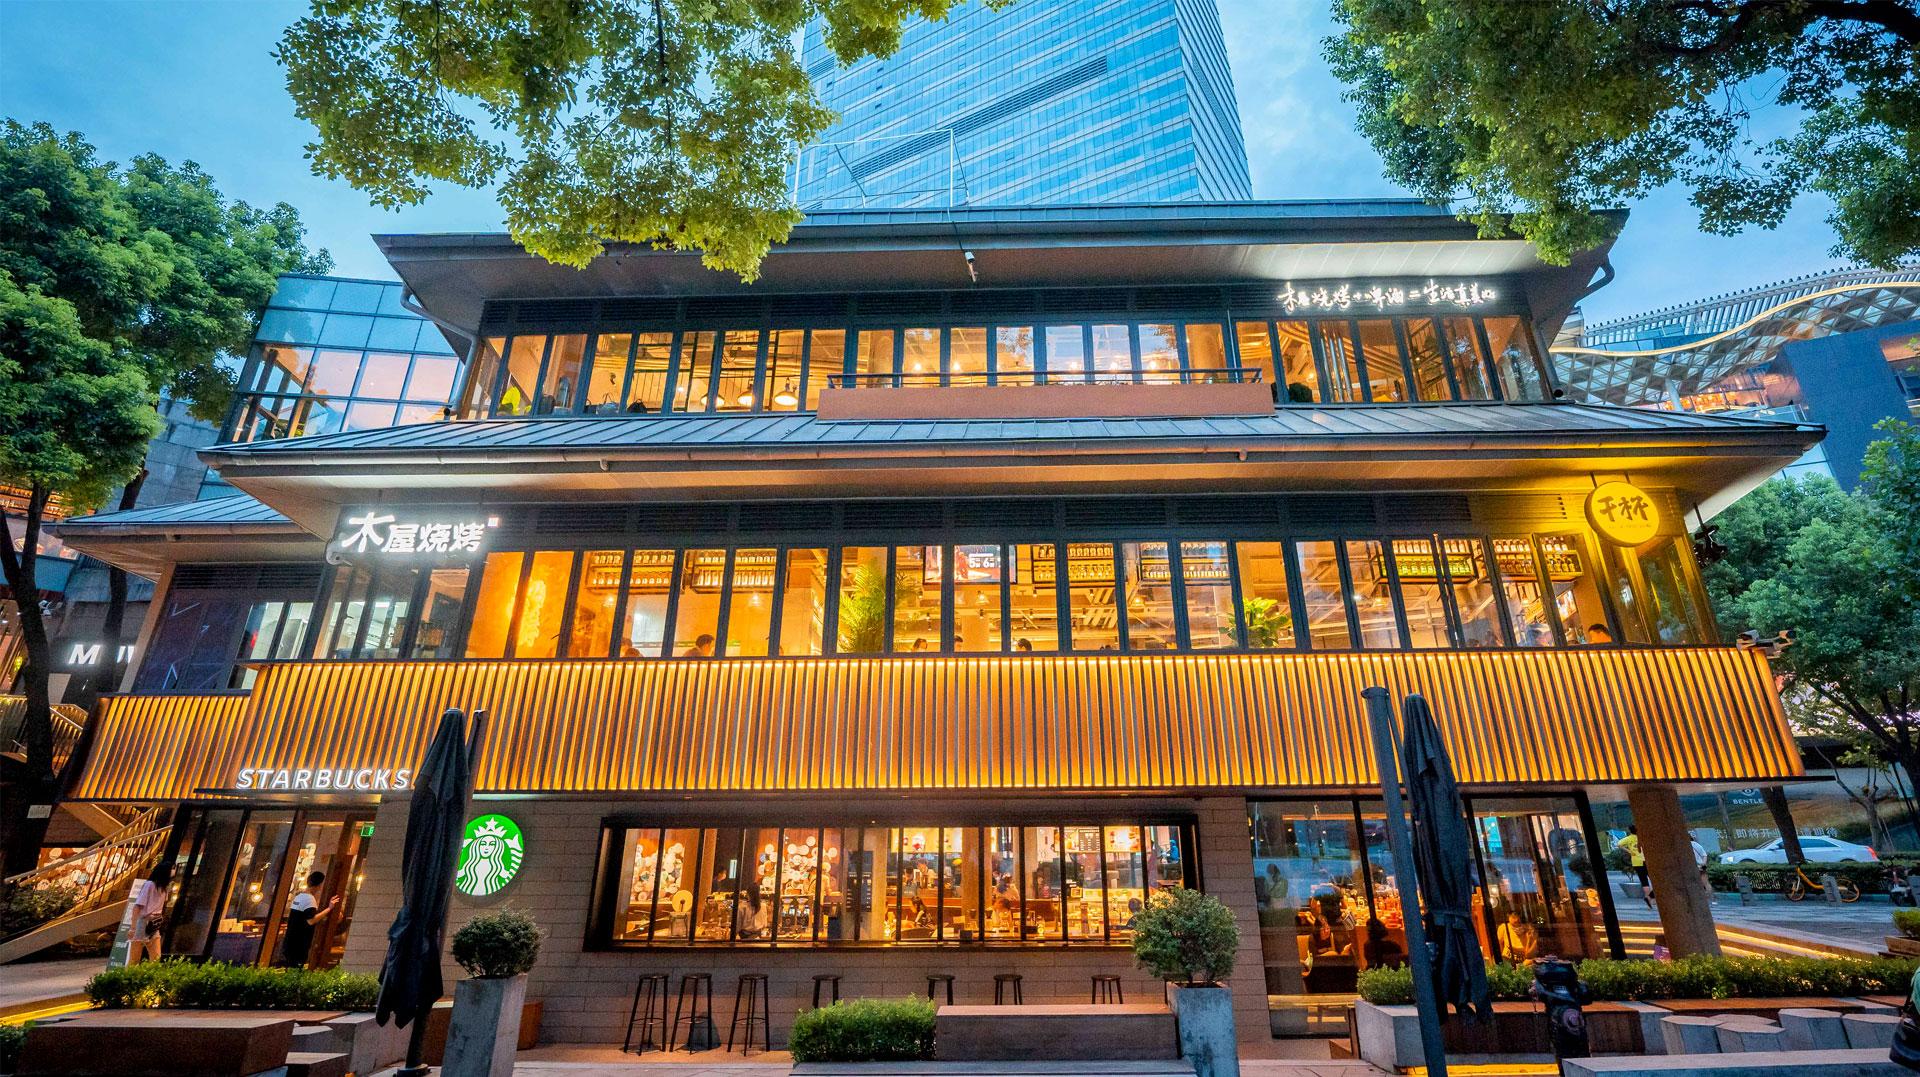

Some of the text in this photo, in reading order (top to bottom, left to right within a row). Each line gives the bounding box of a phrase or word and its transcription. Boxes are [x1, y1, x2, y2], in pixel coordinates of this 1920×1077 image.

[1597, 495, 1649, 522] 干杯
[341, 512, 485, 553] 木屋烧烤
[235, 768, 412, 790] STARBUCKS
